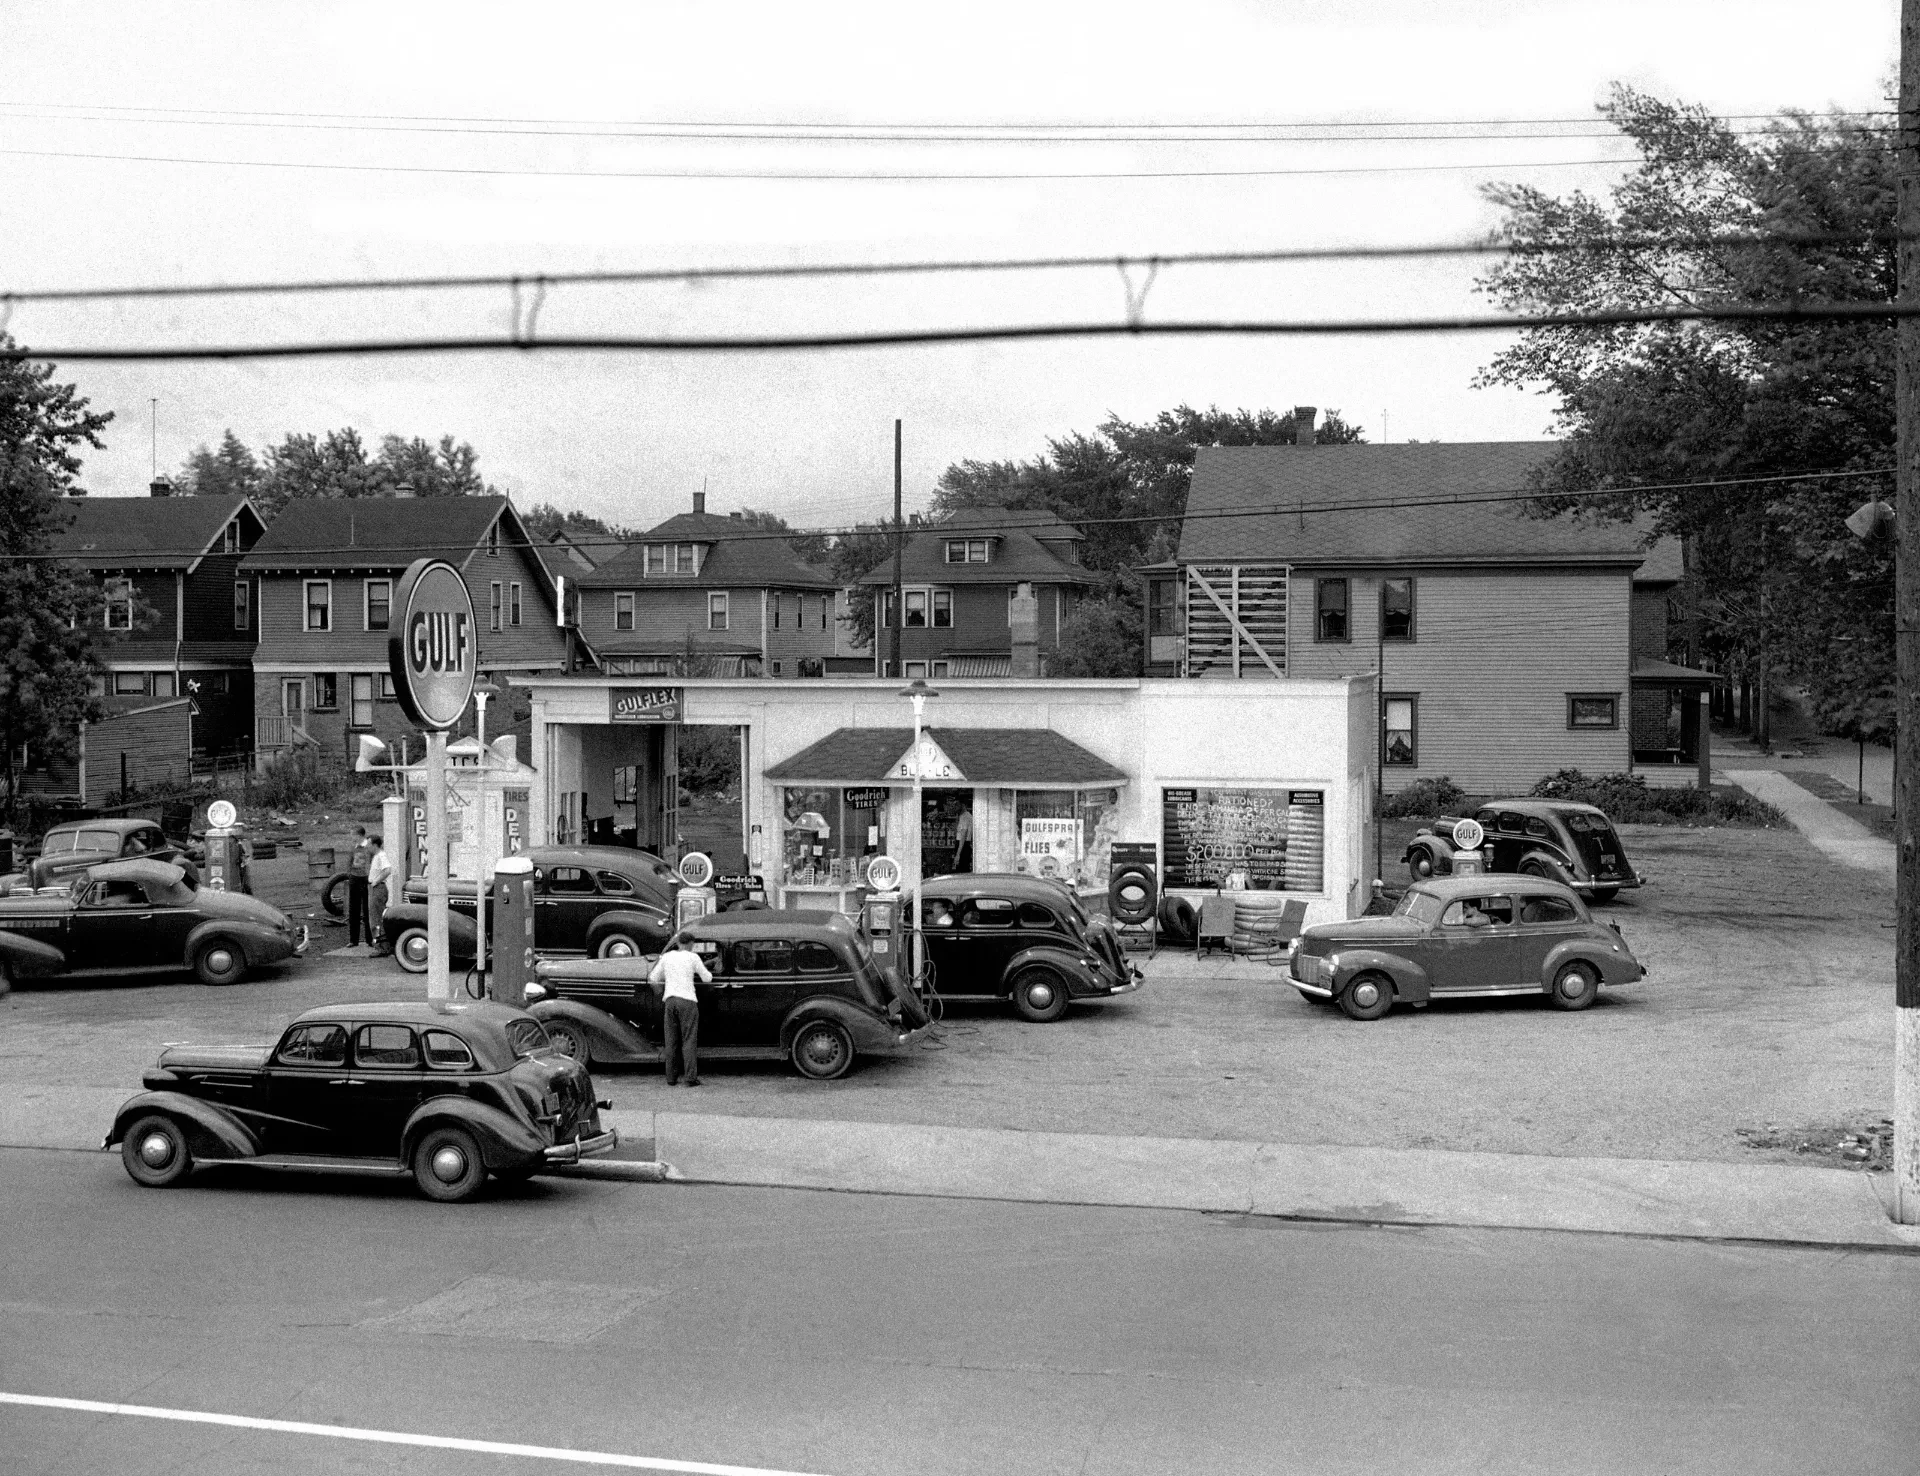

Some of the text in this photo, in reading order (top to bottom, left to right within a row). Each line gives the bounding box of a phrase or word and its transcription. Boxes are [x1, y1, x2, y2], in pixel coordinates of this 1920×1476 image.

[409, 610, 470, 678] GULF
[615, 688, 678, 715] GULFLEX
[411, 790, 427, 802] TIR
[503, 790, 528, 802] TIRES
[846, 787, 886, 802] Goodrich
[855, 800, 878, 809] TIRES
[1219, 796, 1274, 808] RATIONED?
[1260, 808, 1275, 816] PER
[505, 808, 523, 855] DEN
[1456, 828, 1478, 840] GULF
[1024, 841, 1051, 854] FLIES
[1255, 848, 1269, 856] PER
[683, 863, 705, 875] GULF
[872, 867, 894, 879] GULF
[719, 875, 758, 883] Goodrich
